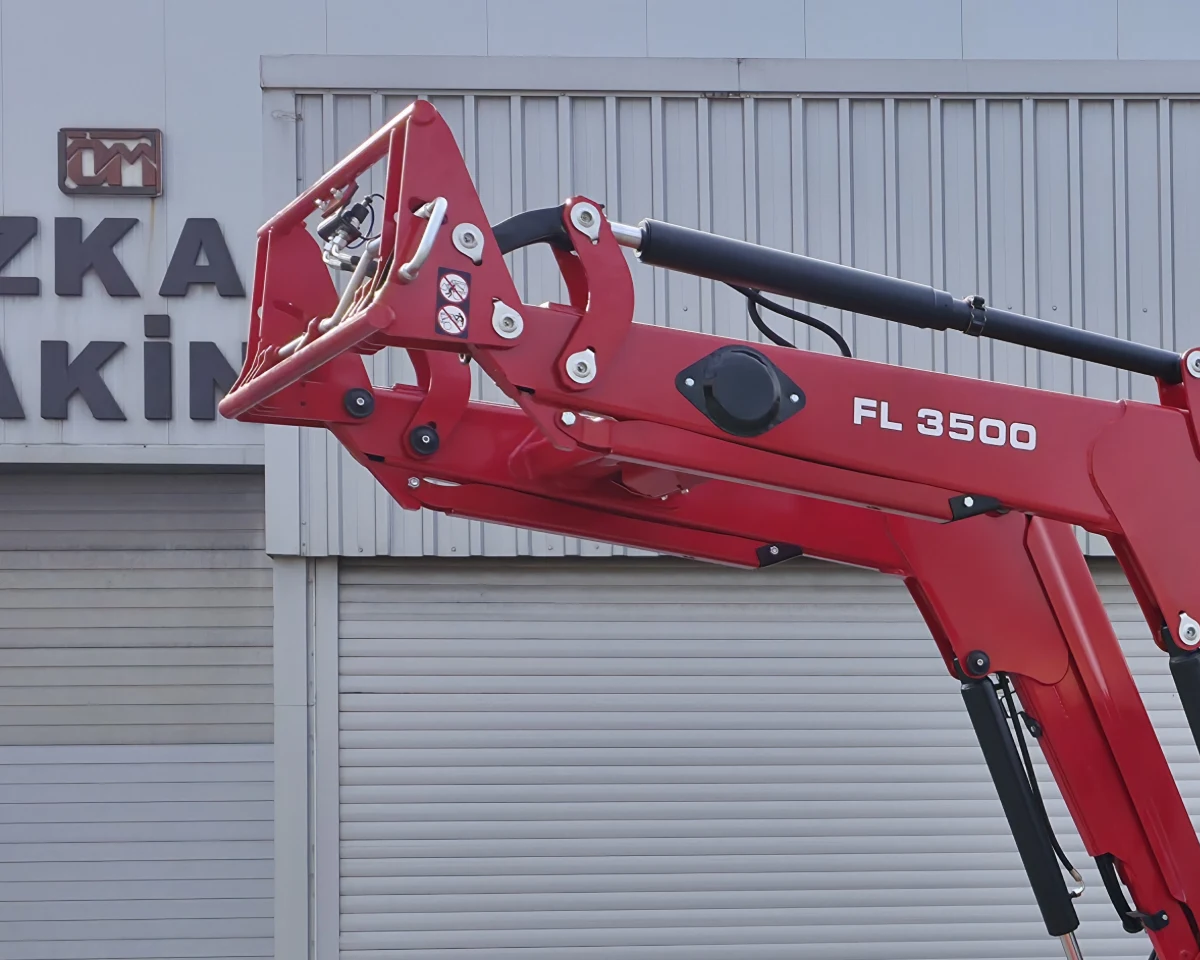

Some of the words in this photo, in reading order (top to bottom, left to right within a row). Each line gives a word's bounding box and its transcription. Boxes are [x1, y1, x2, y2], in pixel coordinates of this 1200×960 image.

[0, 314, 249, 421] KİN
[853, 396, 903, 432] FL
[916, 407, 1037, 451] 3500
